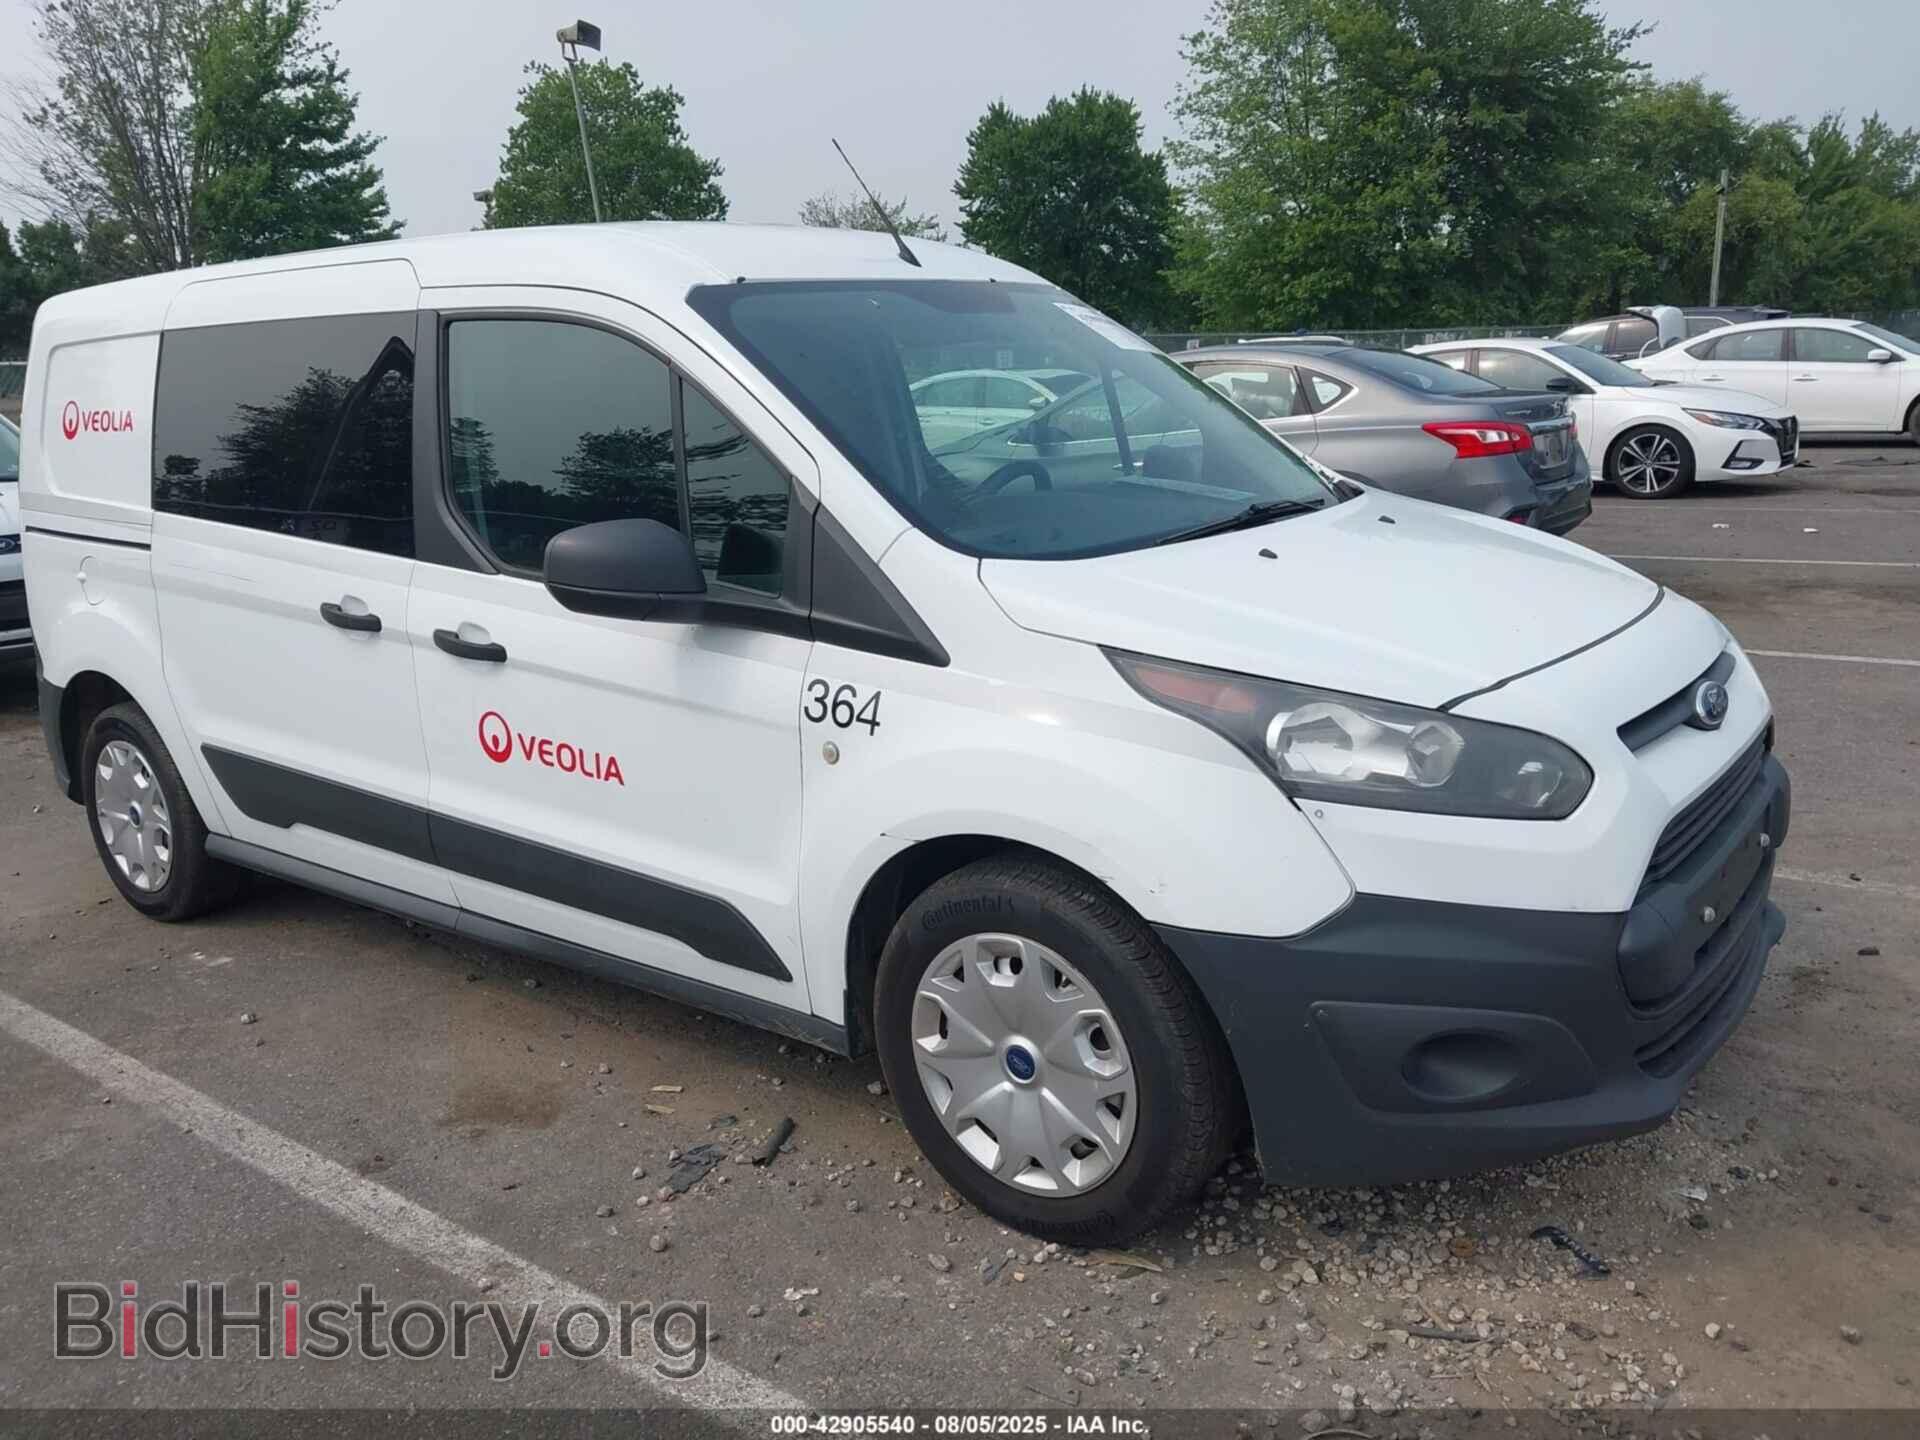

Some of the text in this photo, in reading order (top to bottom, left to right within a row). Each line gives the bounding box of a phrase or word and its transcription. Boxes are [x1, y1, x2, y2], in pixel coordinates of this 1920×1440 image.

[82, 410, 133, 432] VEOLIA
[804, 678, 881, 736] 364
[517, 732, 625, 786] VEOLIA
